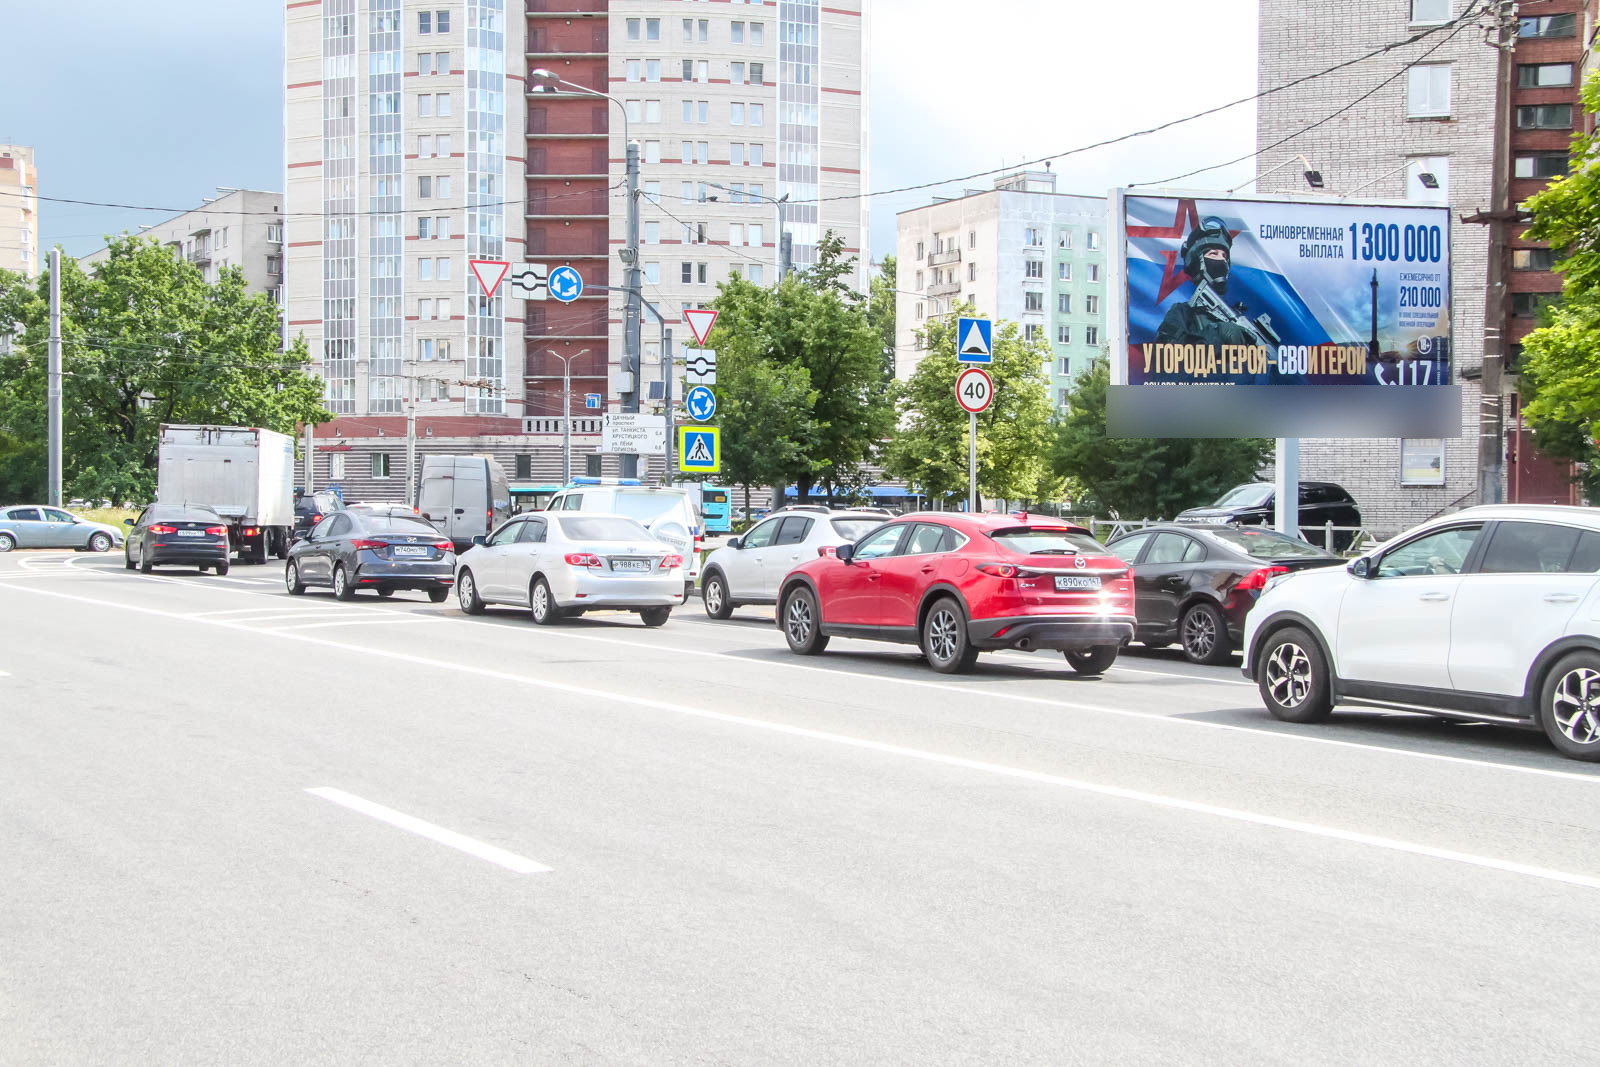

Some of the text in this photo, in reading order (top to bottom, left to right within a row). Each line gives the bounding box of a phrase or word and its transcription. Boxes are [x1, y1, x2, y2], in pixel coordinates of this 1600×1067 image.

[1260, 225, 1344, 241] ЕДИНОВРЕМЕННАЯ
[1299, 244, 1344, 259] ВЫПЛАТА
[1399, 272, 1441, 282] ЕЖЕМЕСЯЧНО ОТ
[1400, 286, 1441, 308] 210 000
[1420, 338, 1431, 351] 18+
[1142, 343, 1153, 374] У
[1155, 343, 1267, 378] ГОРОДА-ГЕРОЯ
[1277, 345, 1318, 375] СВОИ
[1321, 345, 1366, 375] ГЕРОИ
[1396, 360, 1432, 385] 117
[964, 382, 985, 399] 40
